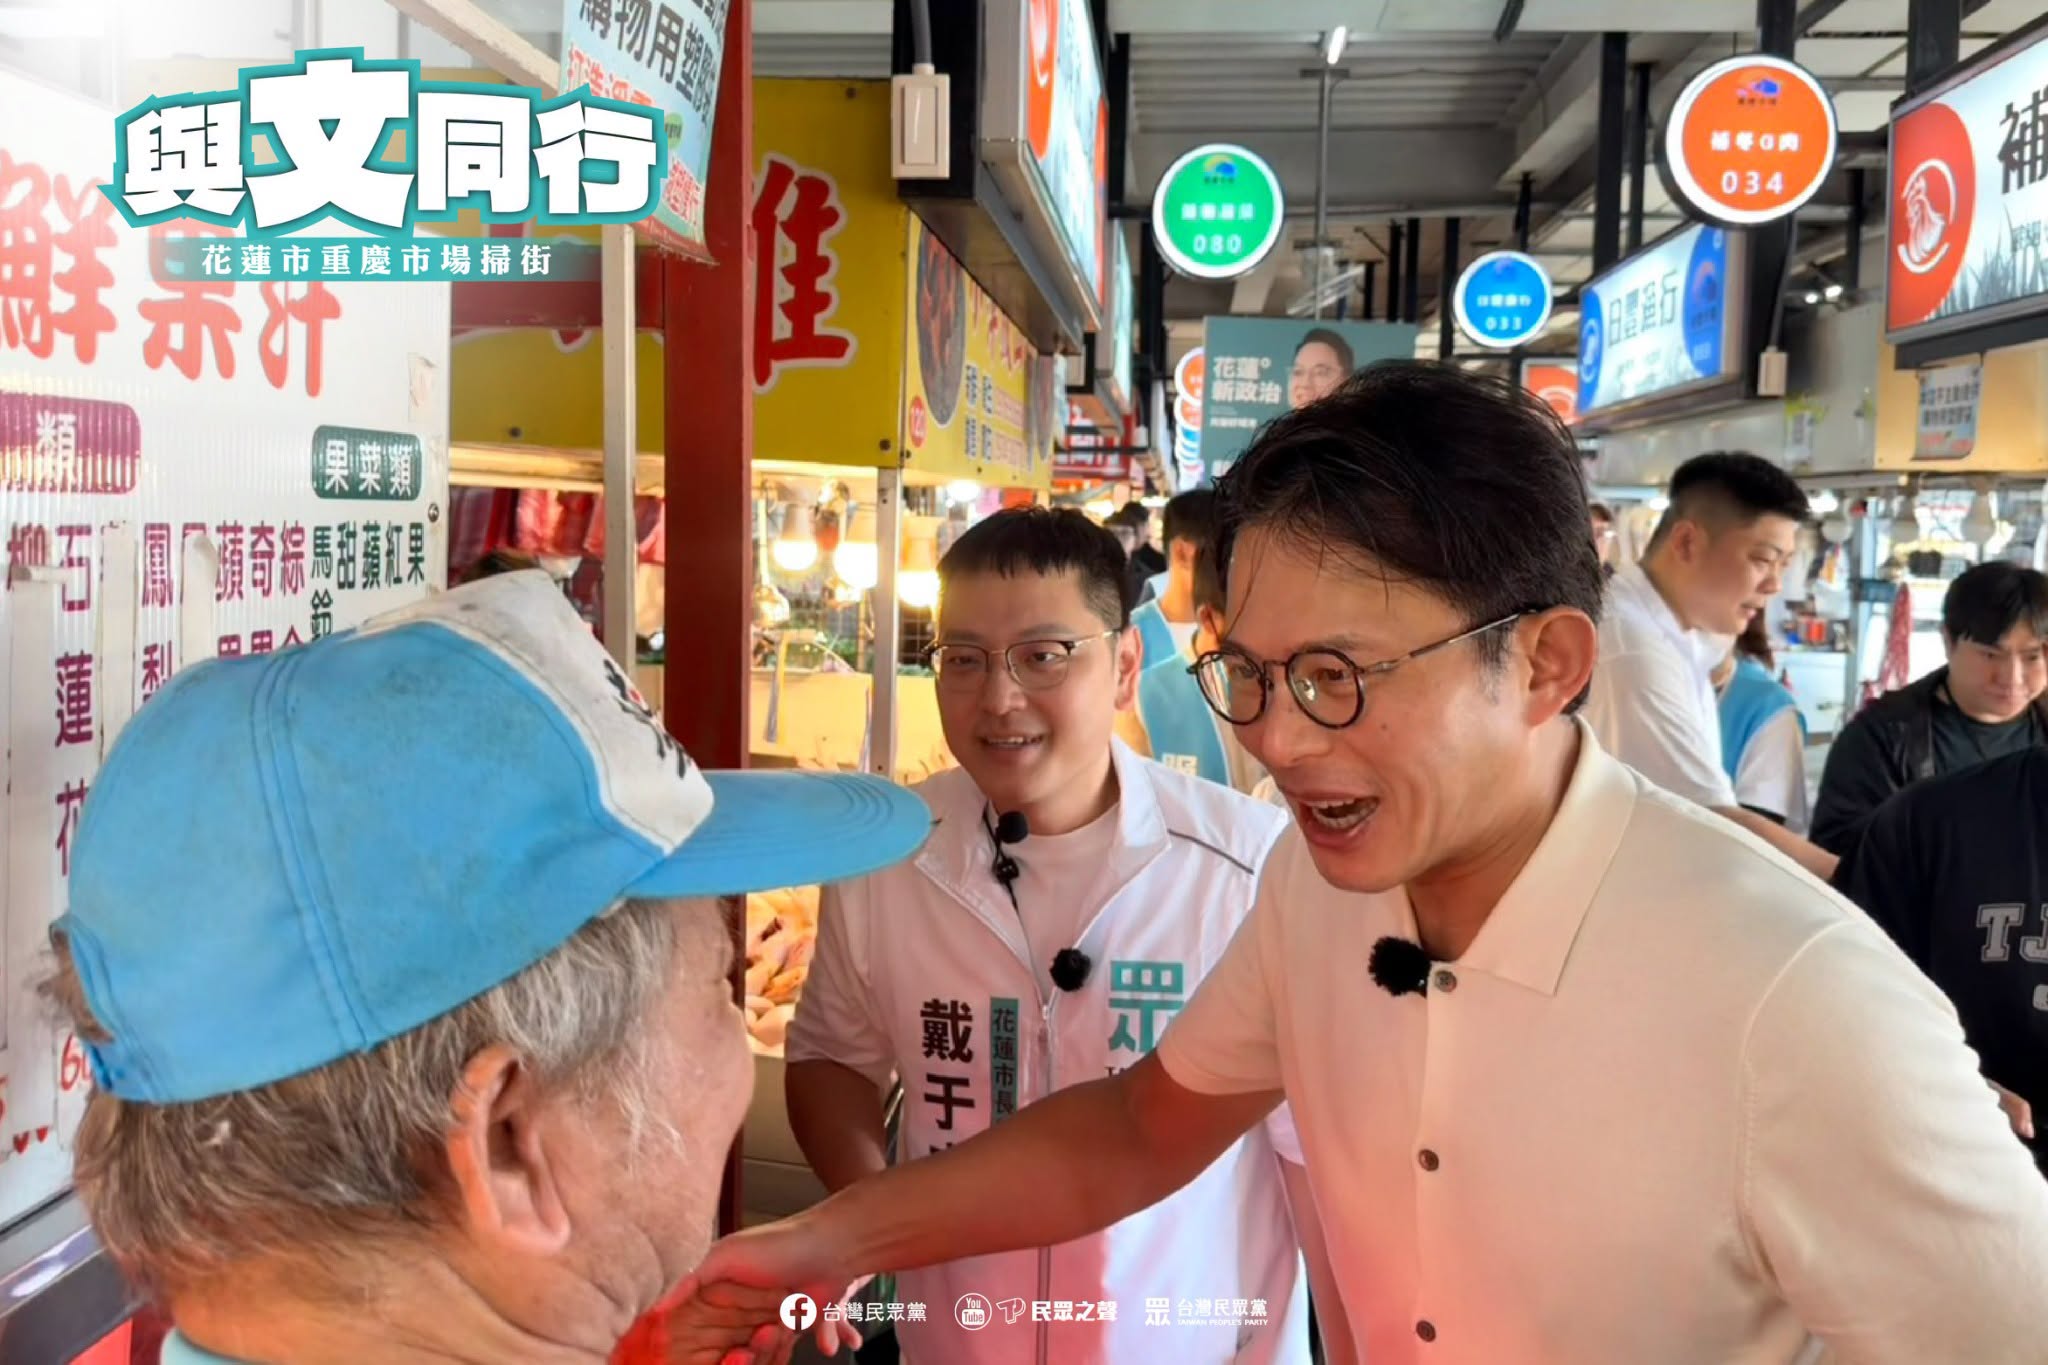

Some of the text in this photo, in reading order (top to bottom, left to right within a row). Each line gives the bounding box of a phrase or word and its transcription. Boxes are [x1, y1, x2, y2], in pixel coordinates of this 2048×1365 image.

[1193, 233, 1242, 255] 080
[1721, 170, 1784, 195] 034
[324, 438, 413, 499] 果菜類
[214, 520, 244, 659] 蘋
[249, 520, 276, 655] 奇
[280, 520, 306, 648] 綜
[919, 998, 977, 1154] 戴于
